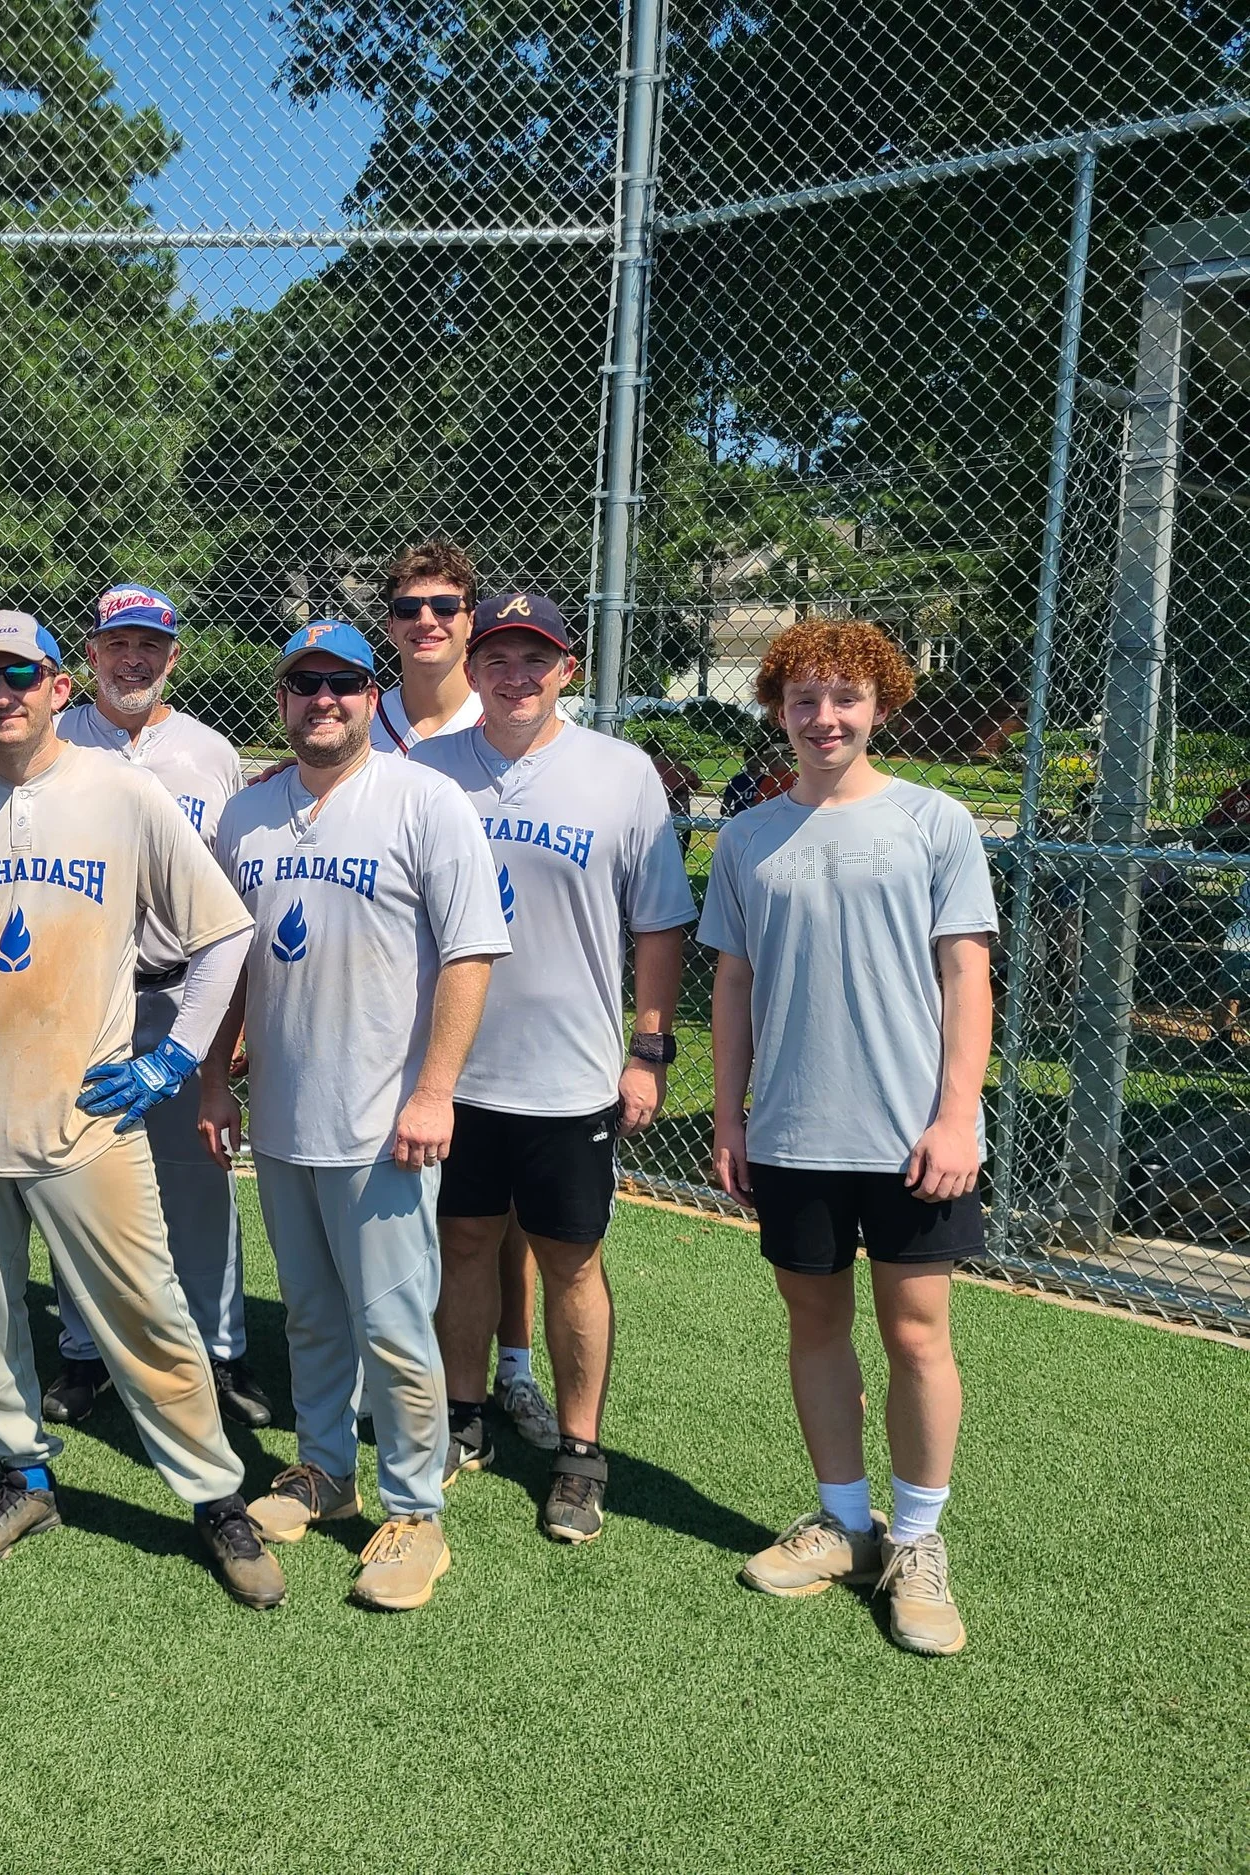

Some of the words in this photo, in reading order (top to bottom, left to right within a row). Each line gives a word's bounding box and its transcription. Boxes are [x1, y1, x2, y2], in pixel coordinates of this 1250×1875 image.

[106, 594, 156, 619] Braves
[497, 596, 532, 619] A
[305, 624, 333, 646] F
[480, 817, 595, 871] HADASH
[238, 859, 264, 897] OR
[275, 856, 379, 902] HADASH
